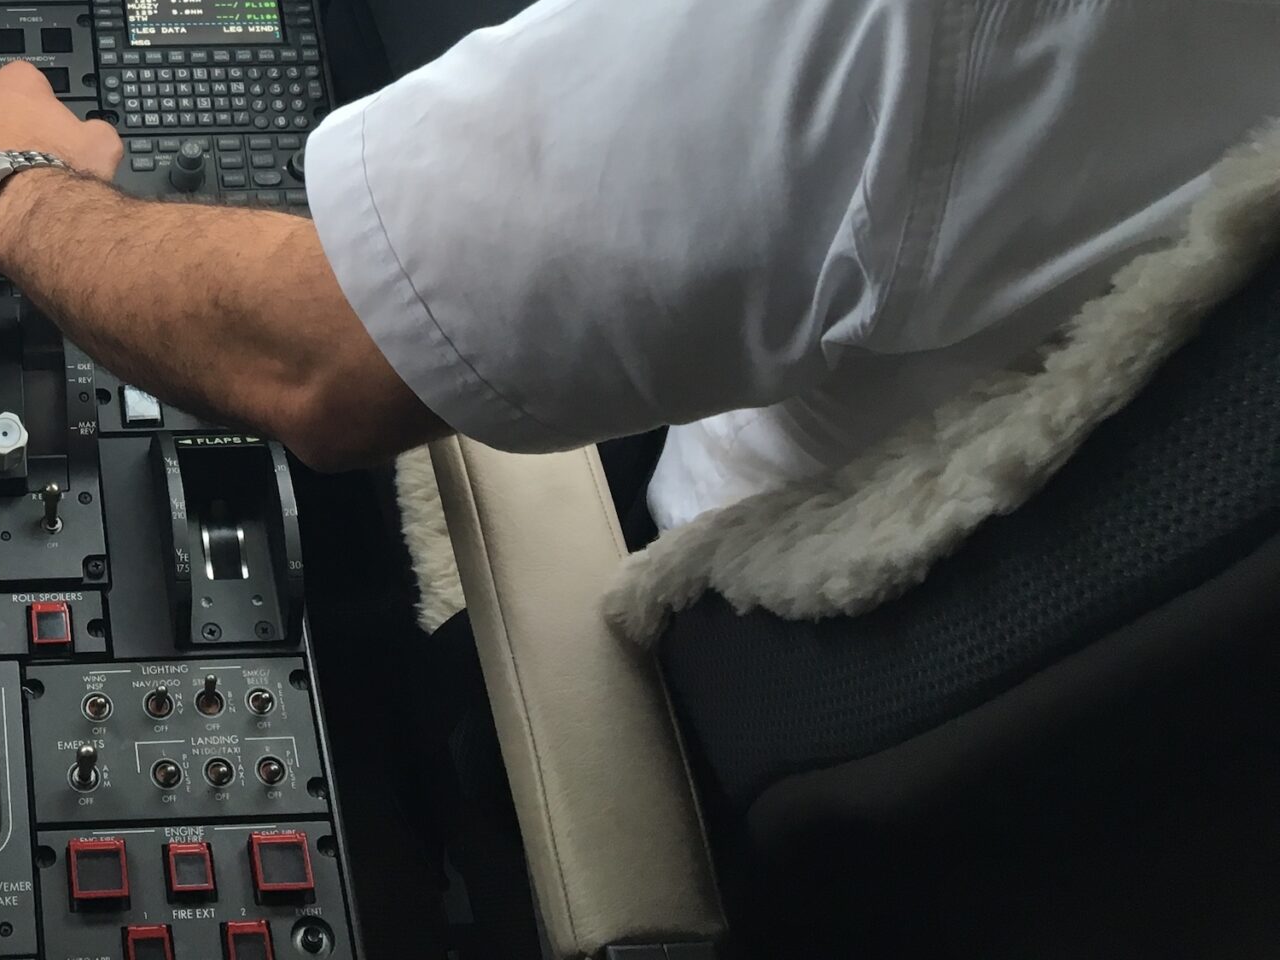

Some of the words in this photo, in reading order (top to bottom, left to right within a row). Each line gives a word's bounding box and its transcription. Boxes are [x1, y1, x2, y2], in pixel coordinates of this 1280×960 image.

[161, 26, 187, 34] DATA
[76, 362, 92, 371] IDLE
[77, 376, 92, 384] REV
[78, 420, 96, 429] MAX
[79, 427, 95, 436] REV
[196, 435, 242, 446] FLAPS
[176, 563, 191, 574] 175
[289, 560, 302, 570] 30
[11, 593, 38, 603] ROLL
[39, 592, 83, 602] SPOILERS
[141, 664, 189, 675] LIGHTING
[82, 675, 107, 683] WING
[132, 678, 181, 688] NAV/LOGO
[246, 676, 269, 685] BELTS
[86, 682, 104, 690] INSP
[153, 724, 169, 733] OFF
[205, 722, 221, 731] OFF
[256, 720, 272, 729] OFF
[91, 726, 108, 735] OFF
[191, 735, 240, 746] LANDING
[161, 794, 177, 804] OFF
[215, 792, 230, 801] OFF
[267, 790, 282, 799] OFF
[78, 796, 94, 805] OFF
[164, 825, 204, 837] ENGINE
[168, 835, 185, 843] APU
[187, 834, 203, 843] FIRE
[172, 908, 193, 919] FIRE
[194, 907, 215, 918] EXT
[295, 906, 322, 916] EVENT
